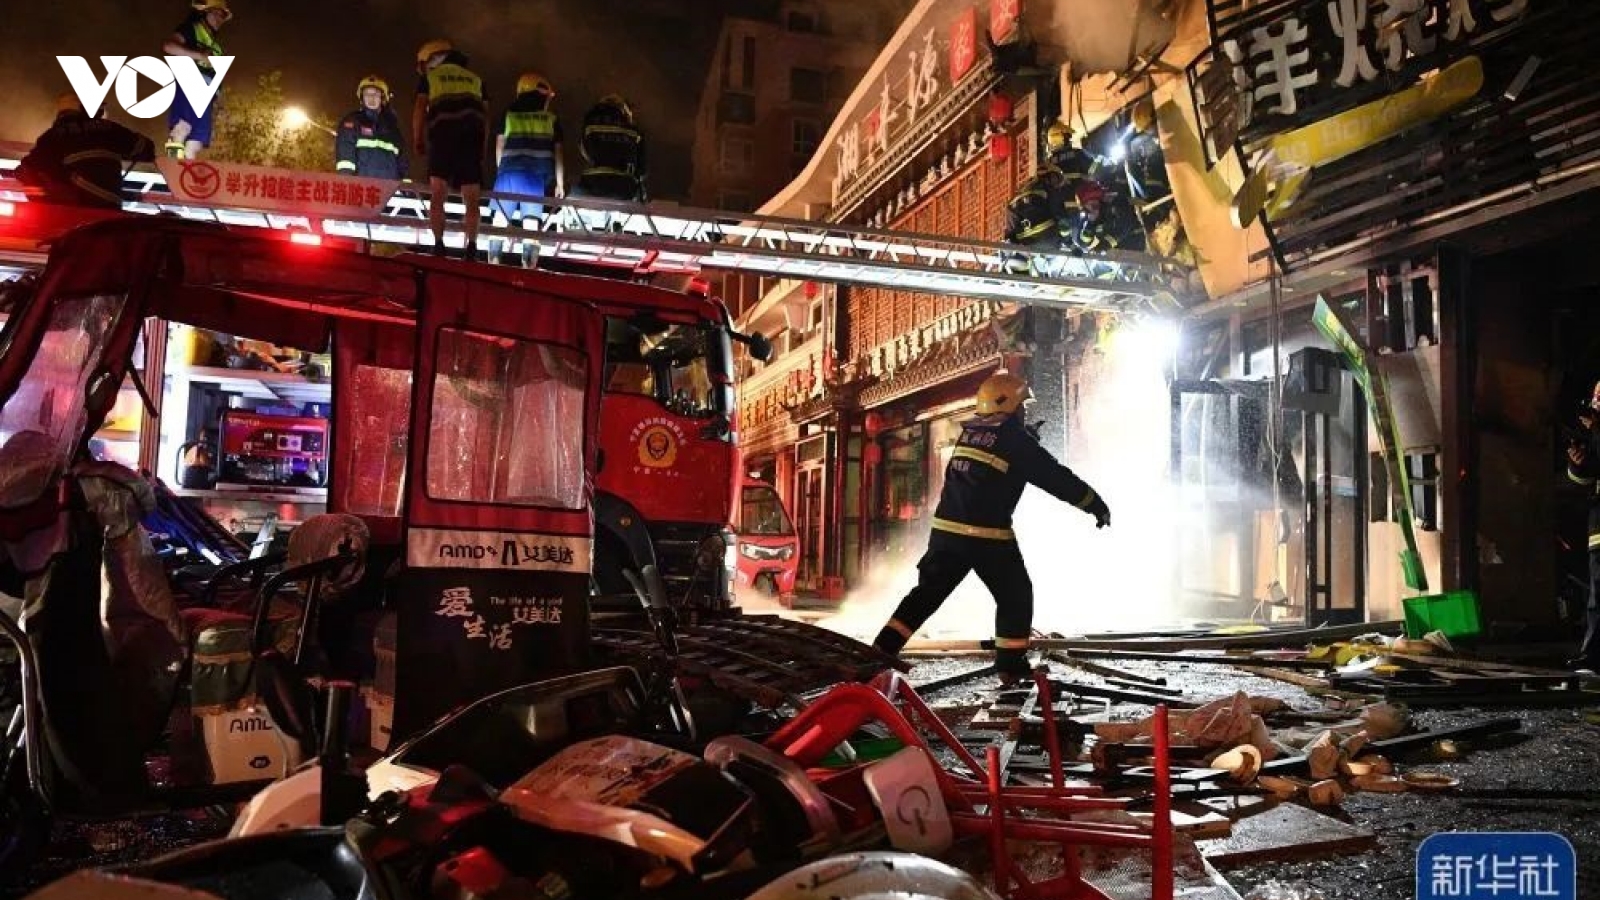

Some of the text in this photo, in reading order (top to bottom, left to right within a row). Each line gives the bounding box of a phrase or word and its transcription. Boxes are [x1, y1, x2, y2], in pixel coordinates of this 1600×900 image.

[521, 545, 575, 564] 艾美达
[435, 586, 512, 649] 爱生活
